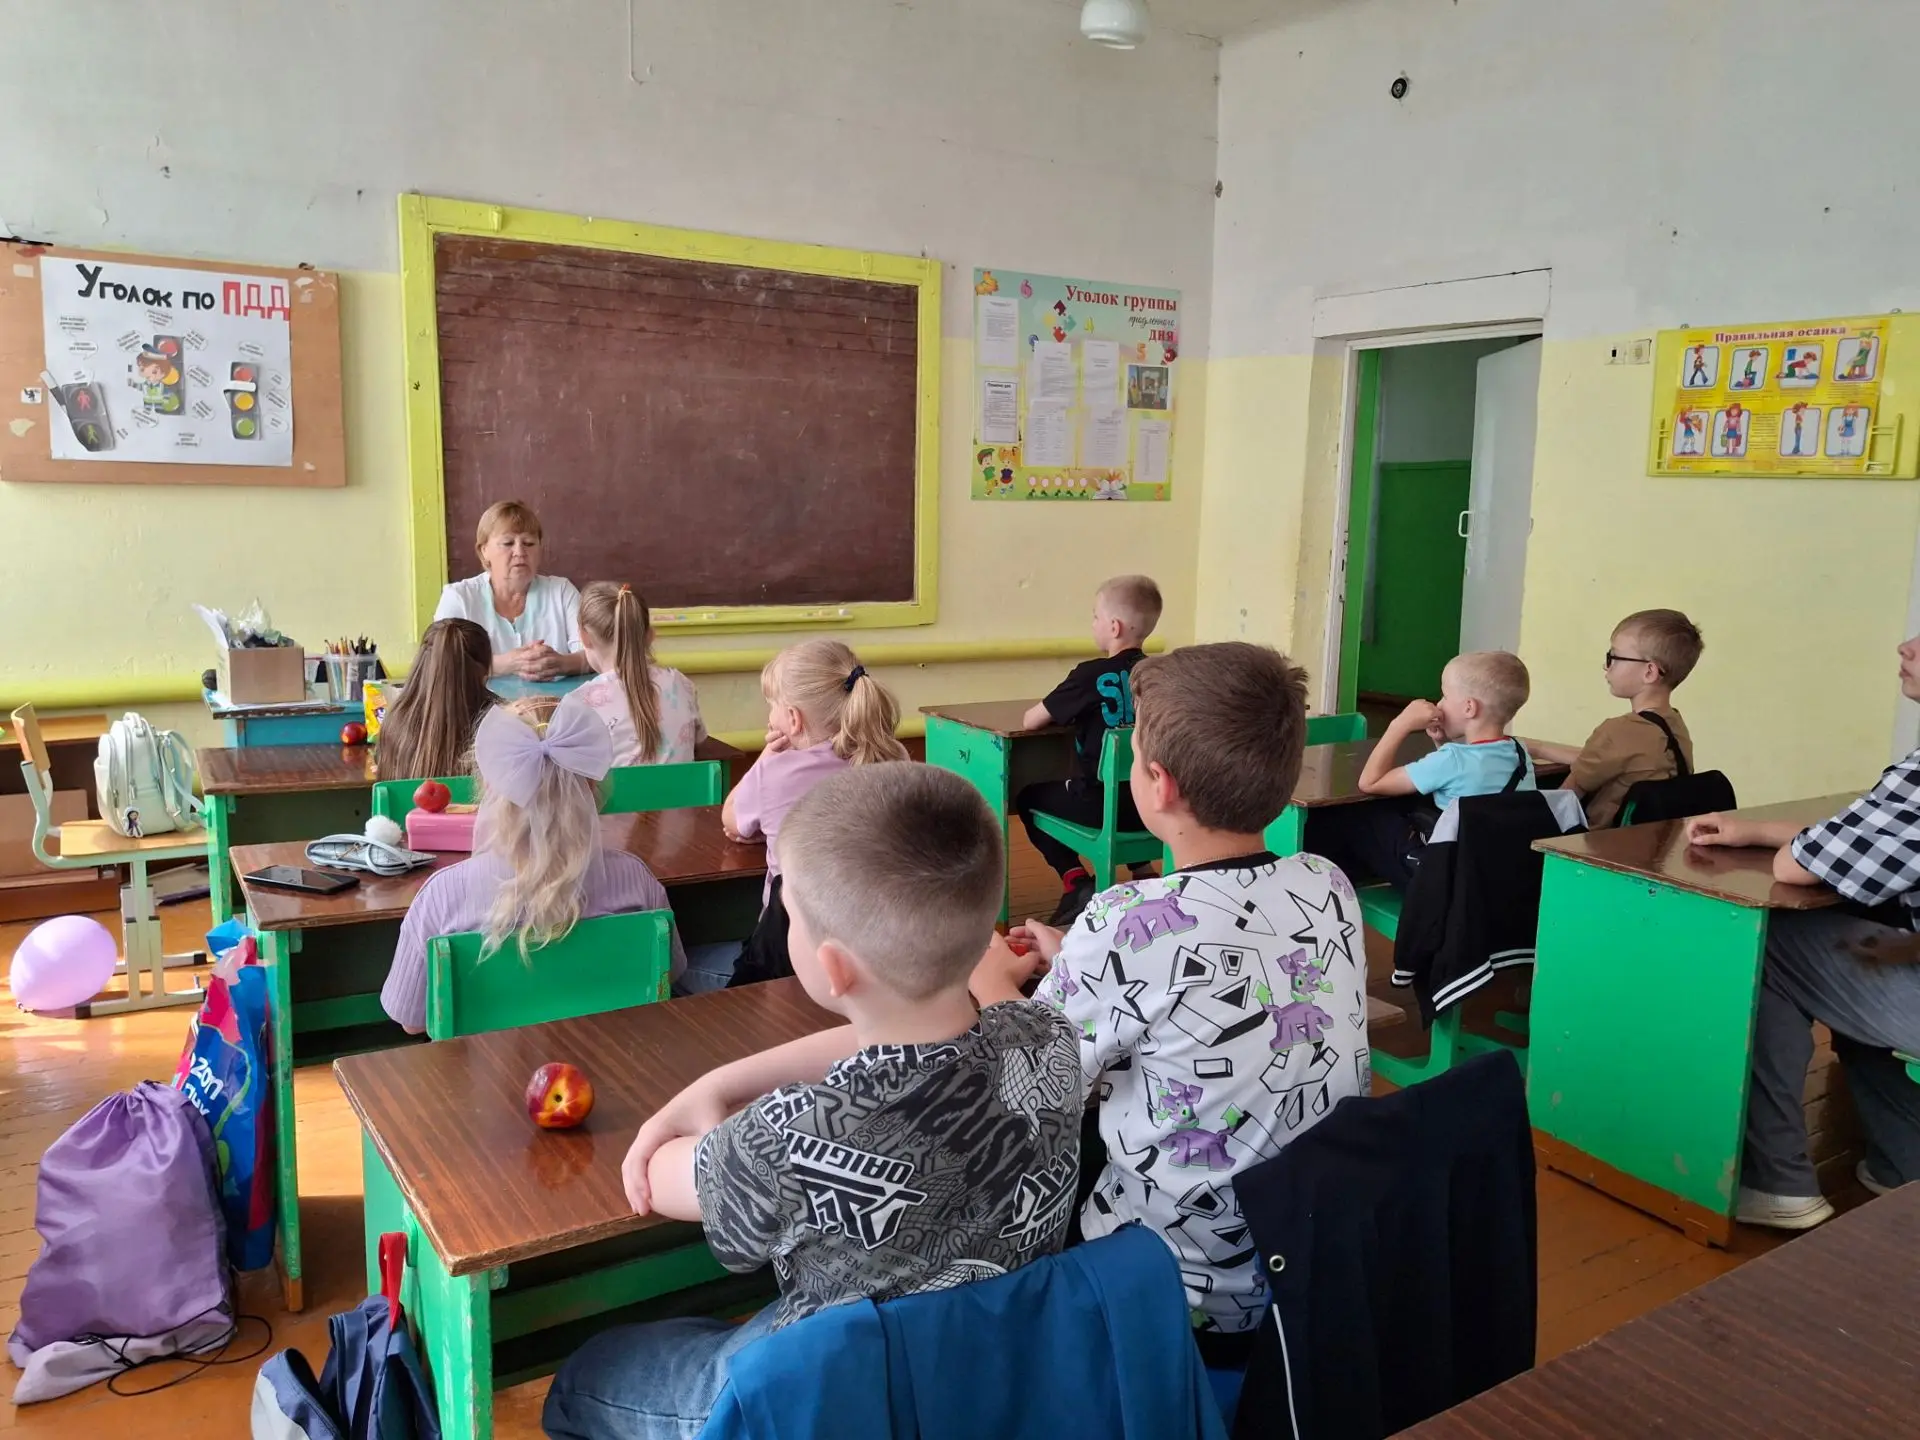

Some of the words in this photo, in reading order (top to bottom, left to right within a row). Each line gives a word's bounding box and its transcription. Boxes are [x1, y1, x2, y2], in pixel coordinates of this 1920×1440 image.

[76, 264, 173, 308] Уголок
[183, 291, 215, 310] по
[223, 281, 290, 321] ПДД
[1066, 285, 1119, 306] Уголок
[1124, 295, 1177, 312] группы
[1149, 329, 1174, 342] дня
[1715, 330, 1794, 344] Правильная
[1797, 327, 1846, 337] осанка
[838, 1251, 864, 1271] DEN
[880, 1252, 926, 1275] STRIPES
